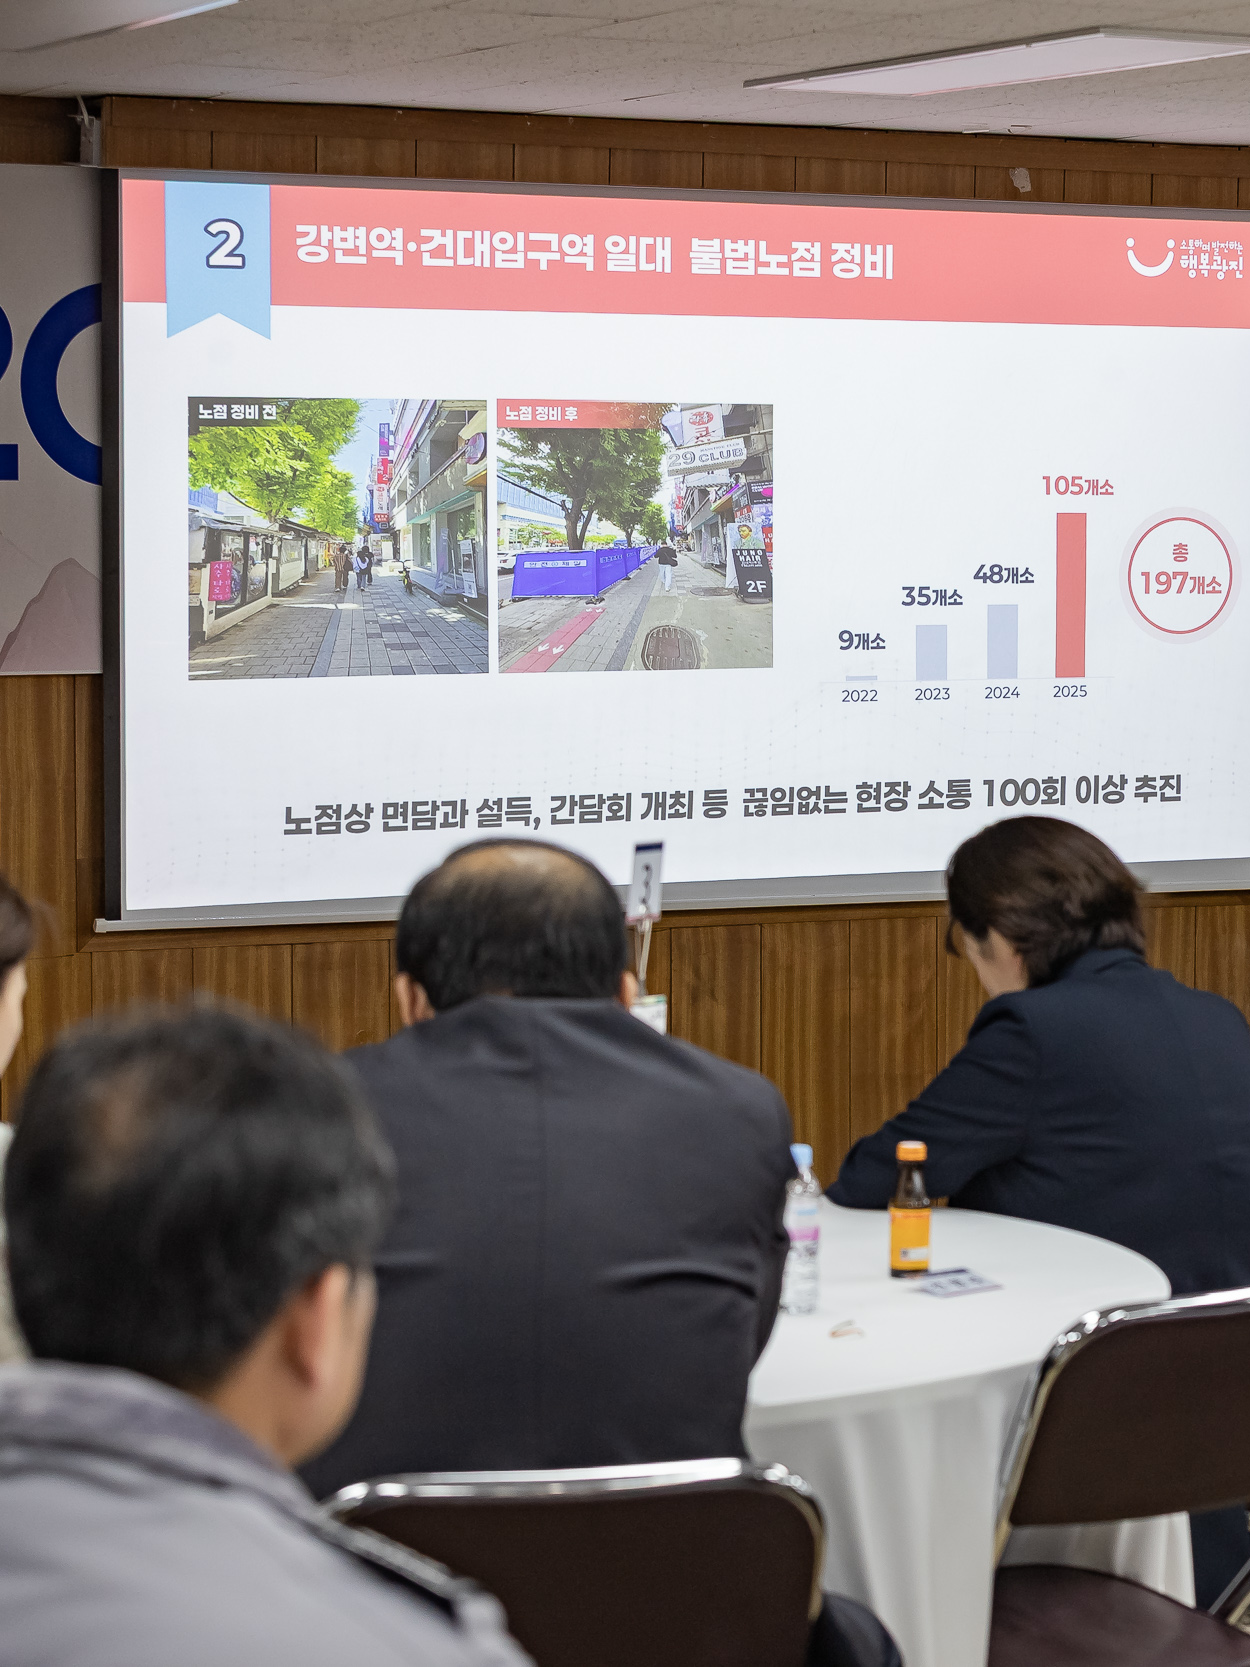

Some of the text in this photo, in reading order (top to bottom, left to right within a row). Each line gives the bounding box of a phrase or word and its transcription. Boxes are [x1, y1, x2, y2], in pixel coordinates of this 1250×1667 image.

[203, 217, 245, 270] 2
[295, 225, 894, 280] 강변역·건대입구역 일대 불법노점 정비
[1180, 239, 1244, 256] 소통하며 발전하는
[1180, 252, 1244, 281] 행복광진
[198, 404, 277, 420] 노점 정비 전
[505, 406, 578, 422] 노점 정비 후
[1042, 475, 1115, 496] 105개소
[1172, 543, 1190, 563] 총
[973, 564, 1035, 585] 48개소
[1141, 571, 1222, 595] 197개소
[746, 580, 767, 593] 2F
[901, 586, 964, 607] 35개소
[838, 629, 886, 651] 9개소
[841, 689, 879, 703] 2022
[914, 687, 951, 701] 2023
[984, 686, 1021, 700] 2024
[1053, 684, 1088, 699] 2025
[283, 773, 1183, 836] 노점상 면담과 설득, 간담회 개최 등 끊임없는 현장 소통 100회 이상 추진
